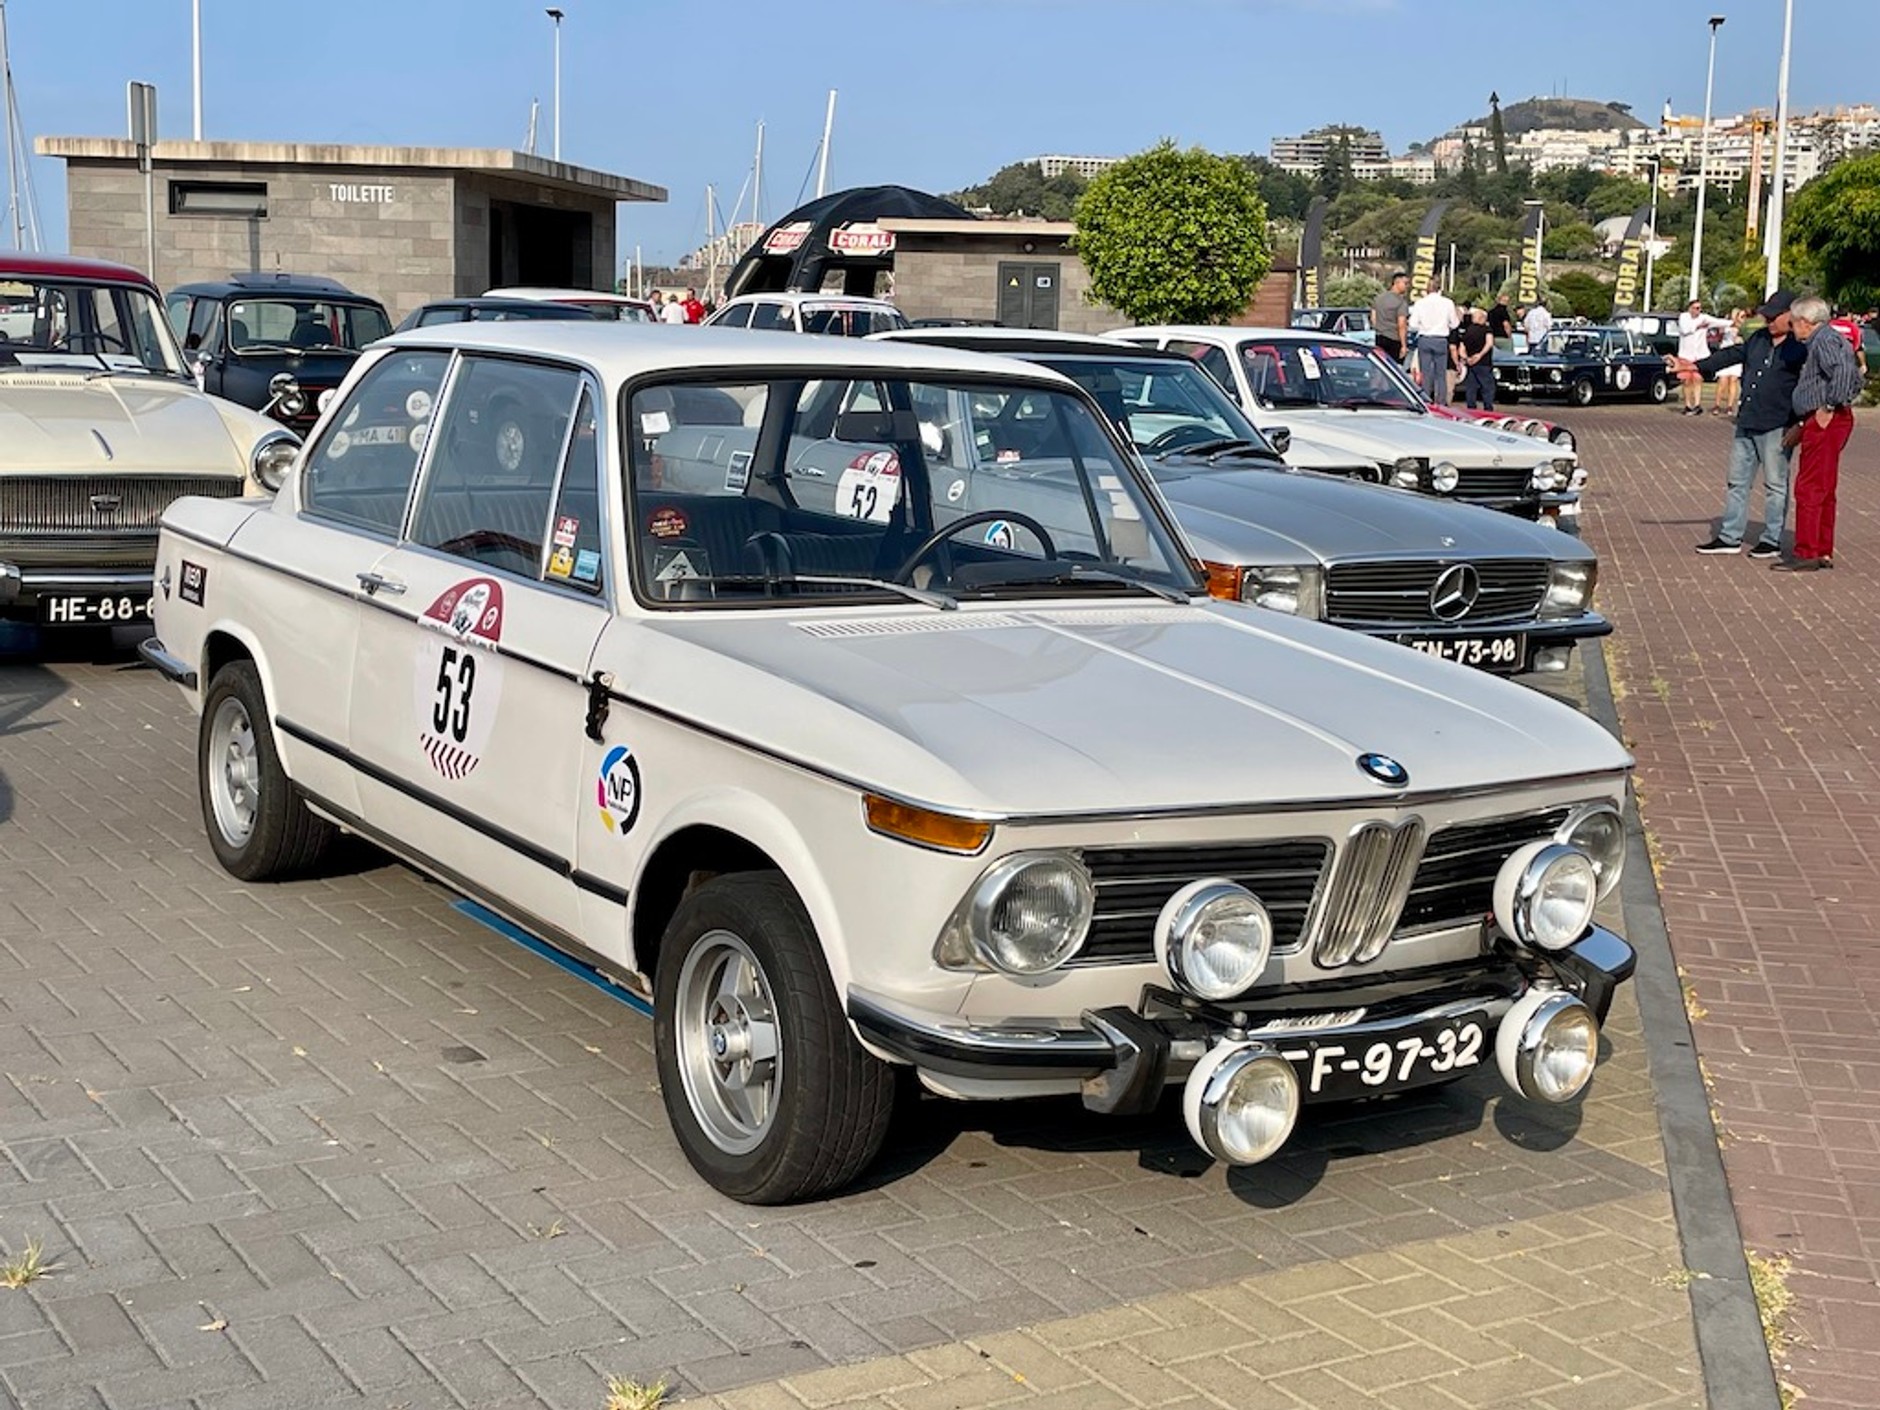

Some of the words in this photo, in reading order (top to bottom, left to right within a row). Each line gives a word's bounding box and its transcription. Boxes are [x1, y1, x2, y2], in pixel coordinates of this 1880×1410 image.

[329, 184, 393, 203] TOILETTE
[836, 233, 891, 248] CORAL
[1305, 266, 1319, 310] CORAL
[1410, 233, 1437, 302] CORAL
[1518, 237, 1538, 304] CORAL
[1614, 238, 1642, 306] CORAL
[851, 484, 877, 519] 52
[433, 646, 475, 743] 53
[607, 773, 632, 801] NP
